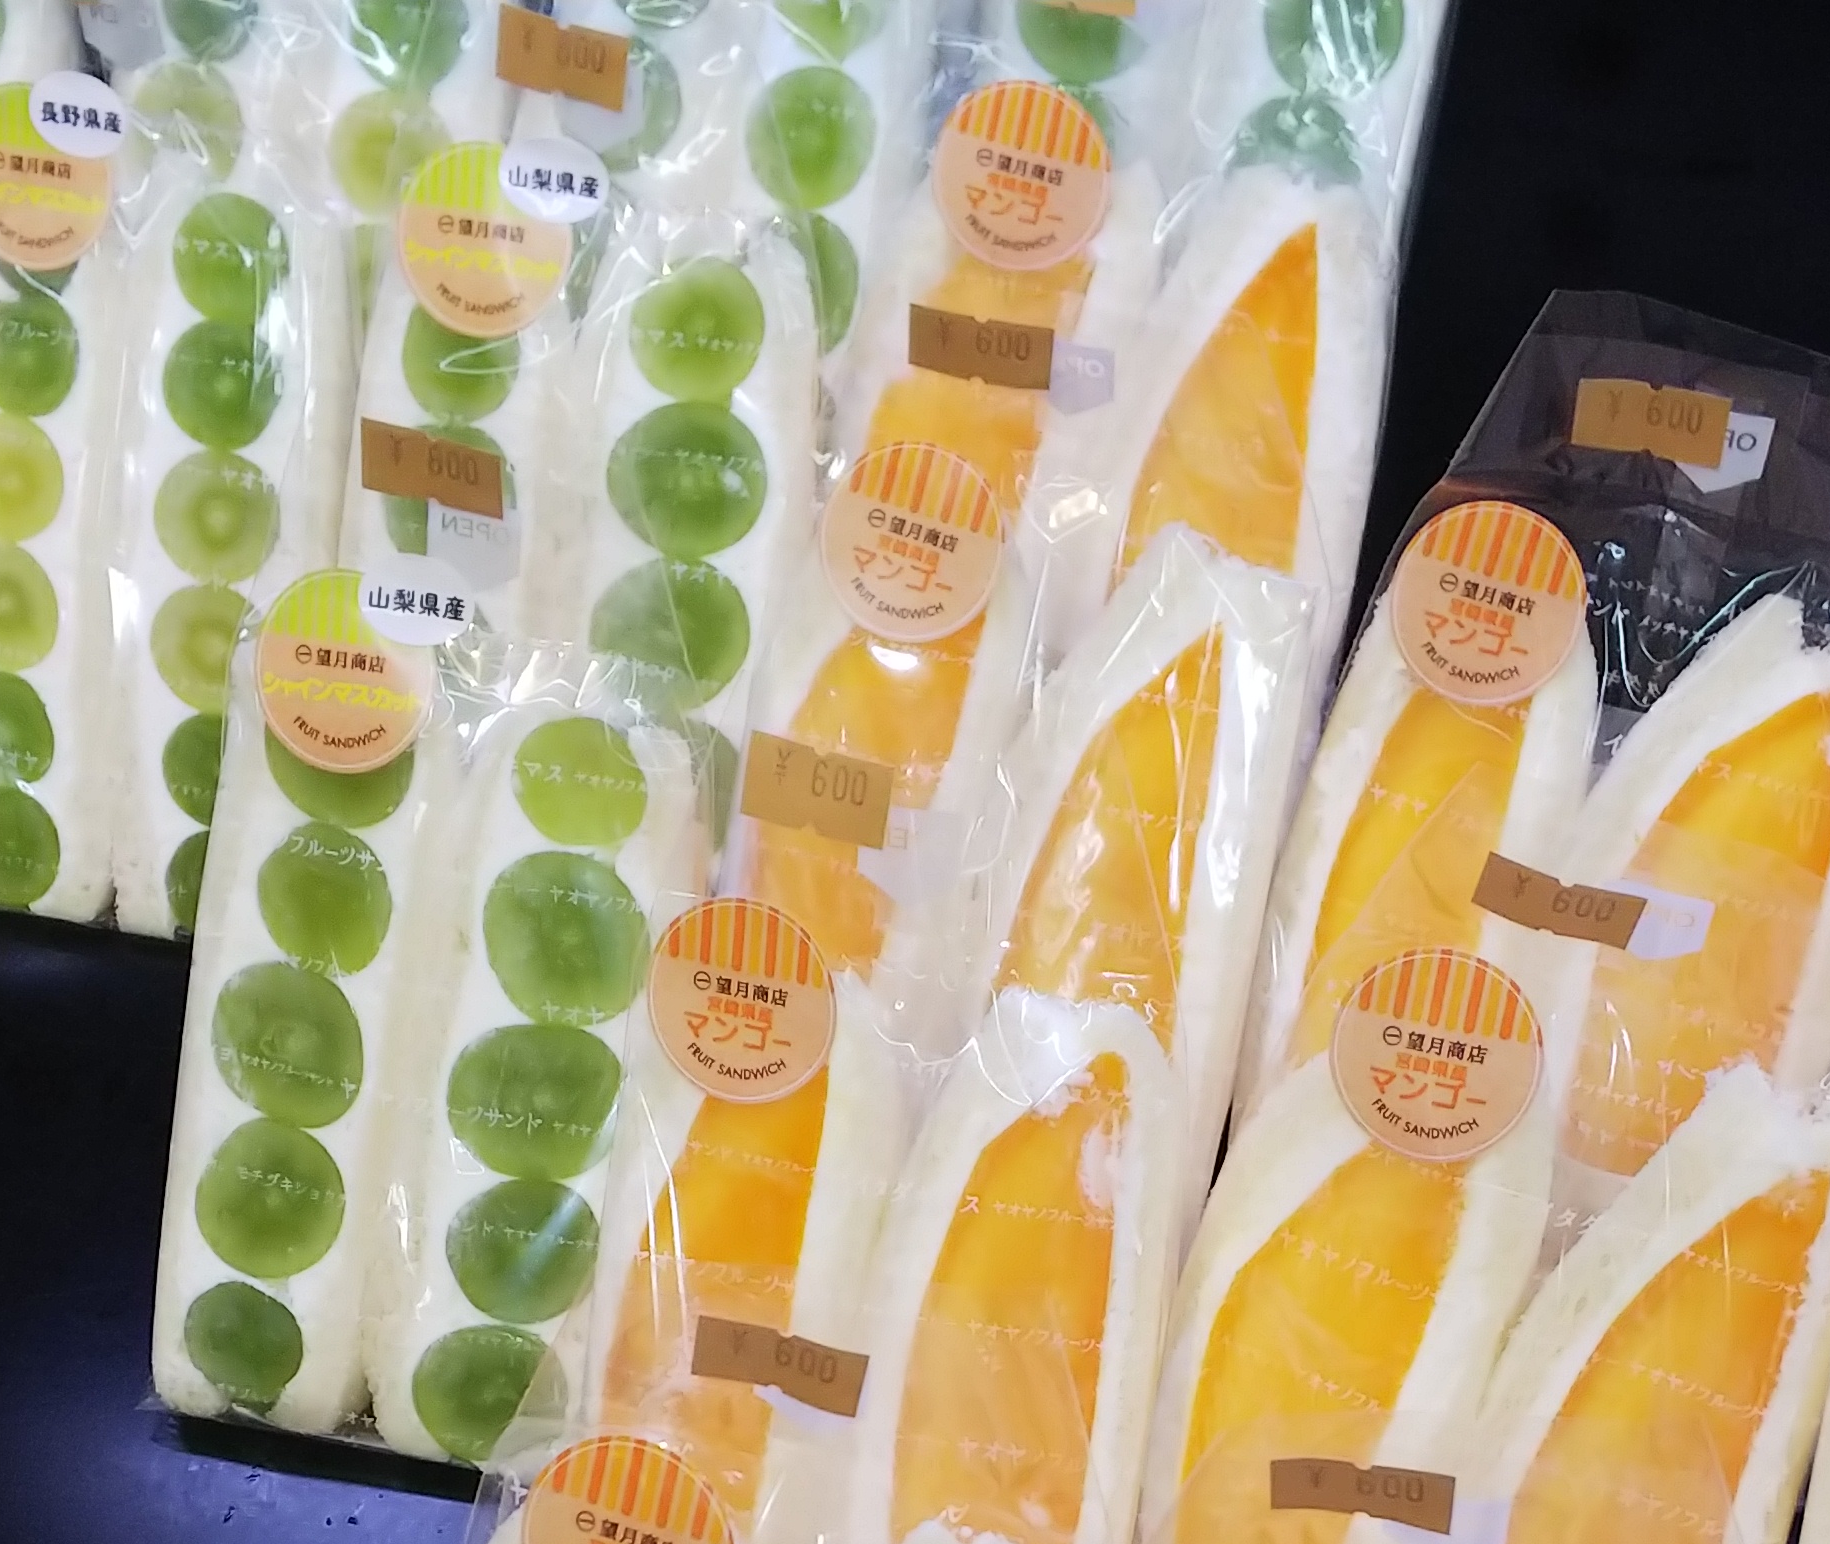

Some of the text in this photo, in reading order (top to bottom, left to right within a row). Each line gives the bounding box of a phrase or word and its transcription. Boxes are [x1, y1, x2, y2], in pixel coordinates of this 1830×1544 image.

[41, 100, 122, 134] 長野県産
[507, 165, 600, 200] 山梨県産
[964, 183, 1064, 226] マンゴー
[975, 326, 1032, 363] 600
[1646, 400, 1706, 437] 600
[427, 443, 480, 487] 600
[889, 515, 960, 554] 望月商店
[853, 544, 954, 594] マンゴー
[367, 585, 466, 622] 山梨県産
[850, 576, 945, 621] FRUIT SANDWICH
[1463, 580, 1536, 618] 望月商店
[1424, 611, 1529, 659] マンゴー
[315, 647, 386, 674] 望月商店
[1421, 641, 1520, 684] FRUIT SANDWICH
[262, 671, 417, 713] シャインマスカット
[293, 714, 387, 748] FRUIT SANDWICH
[773, 747, 868, 807] ¥ 600
[1515, 871, 1617, 924] ¥ 600
[715, 975, 789, 1009] 望月商店
[684, 1010, 792, 1052] マンゴー
[1406, 1031, 1489, 1066] 望月商店
[687, 1042, 787, 1081] FRUIT SANDWICH
[1369, 1064, 1487, 1110] マンゴー
[1370, 1097, 1480, 1140] FRUIT SANDWICH
[775, 1342, 839, 1384] 600
